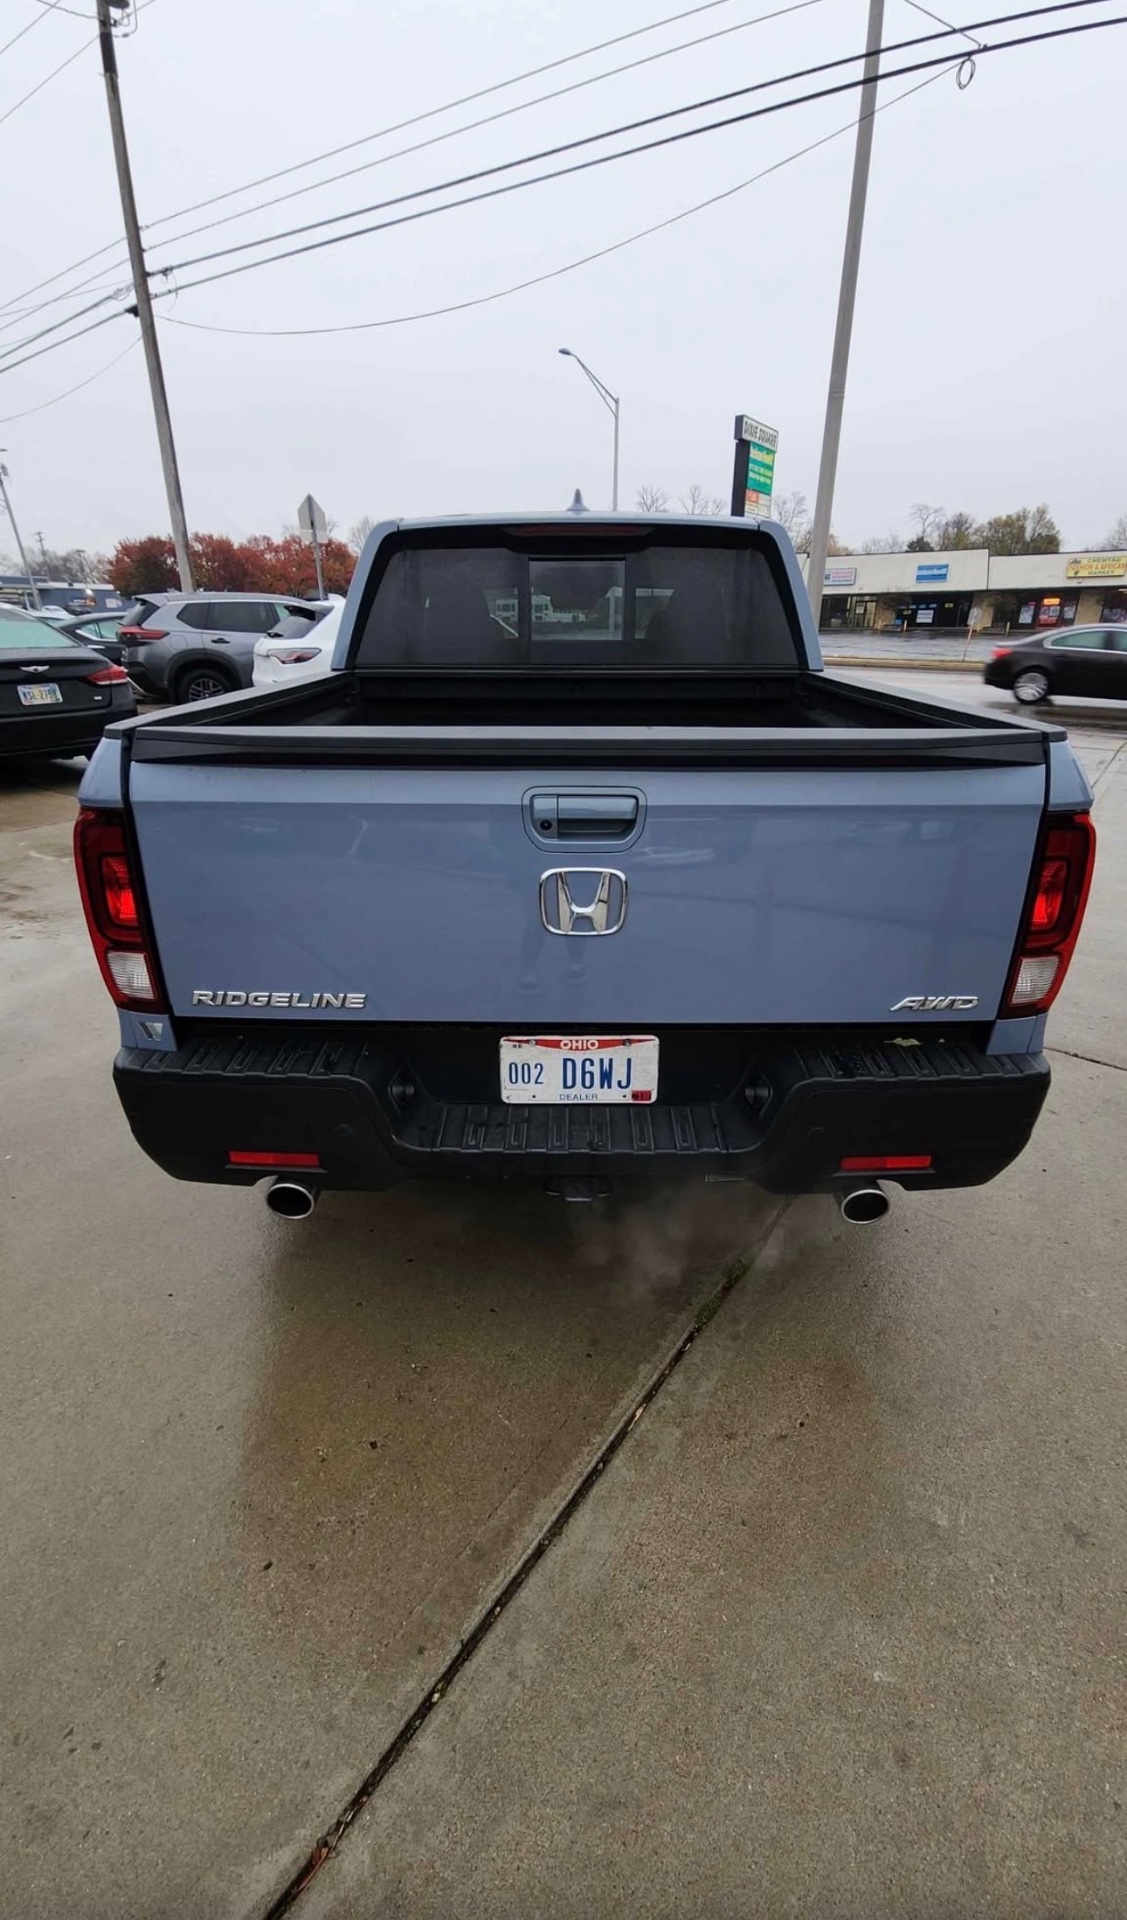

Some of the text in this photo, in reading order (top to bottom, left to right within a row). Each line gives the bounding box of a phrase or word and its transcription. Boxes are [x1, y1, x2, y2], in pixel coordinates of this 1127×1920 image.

[191, 990, 367, 1009] RIDGELINE
[890, 996, 979, 1011] AWD
[560, 1039, 599, 1050] OHIO
[508, 1057, 632, 1089] 002 D6WJ
